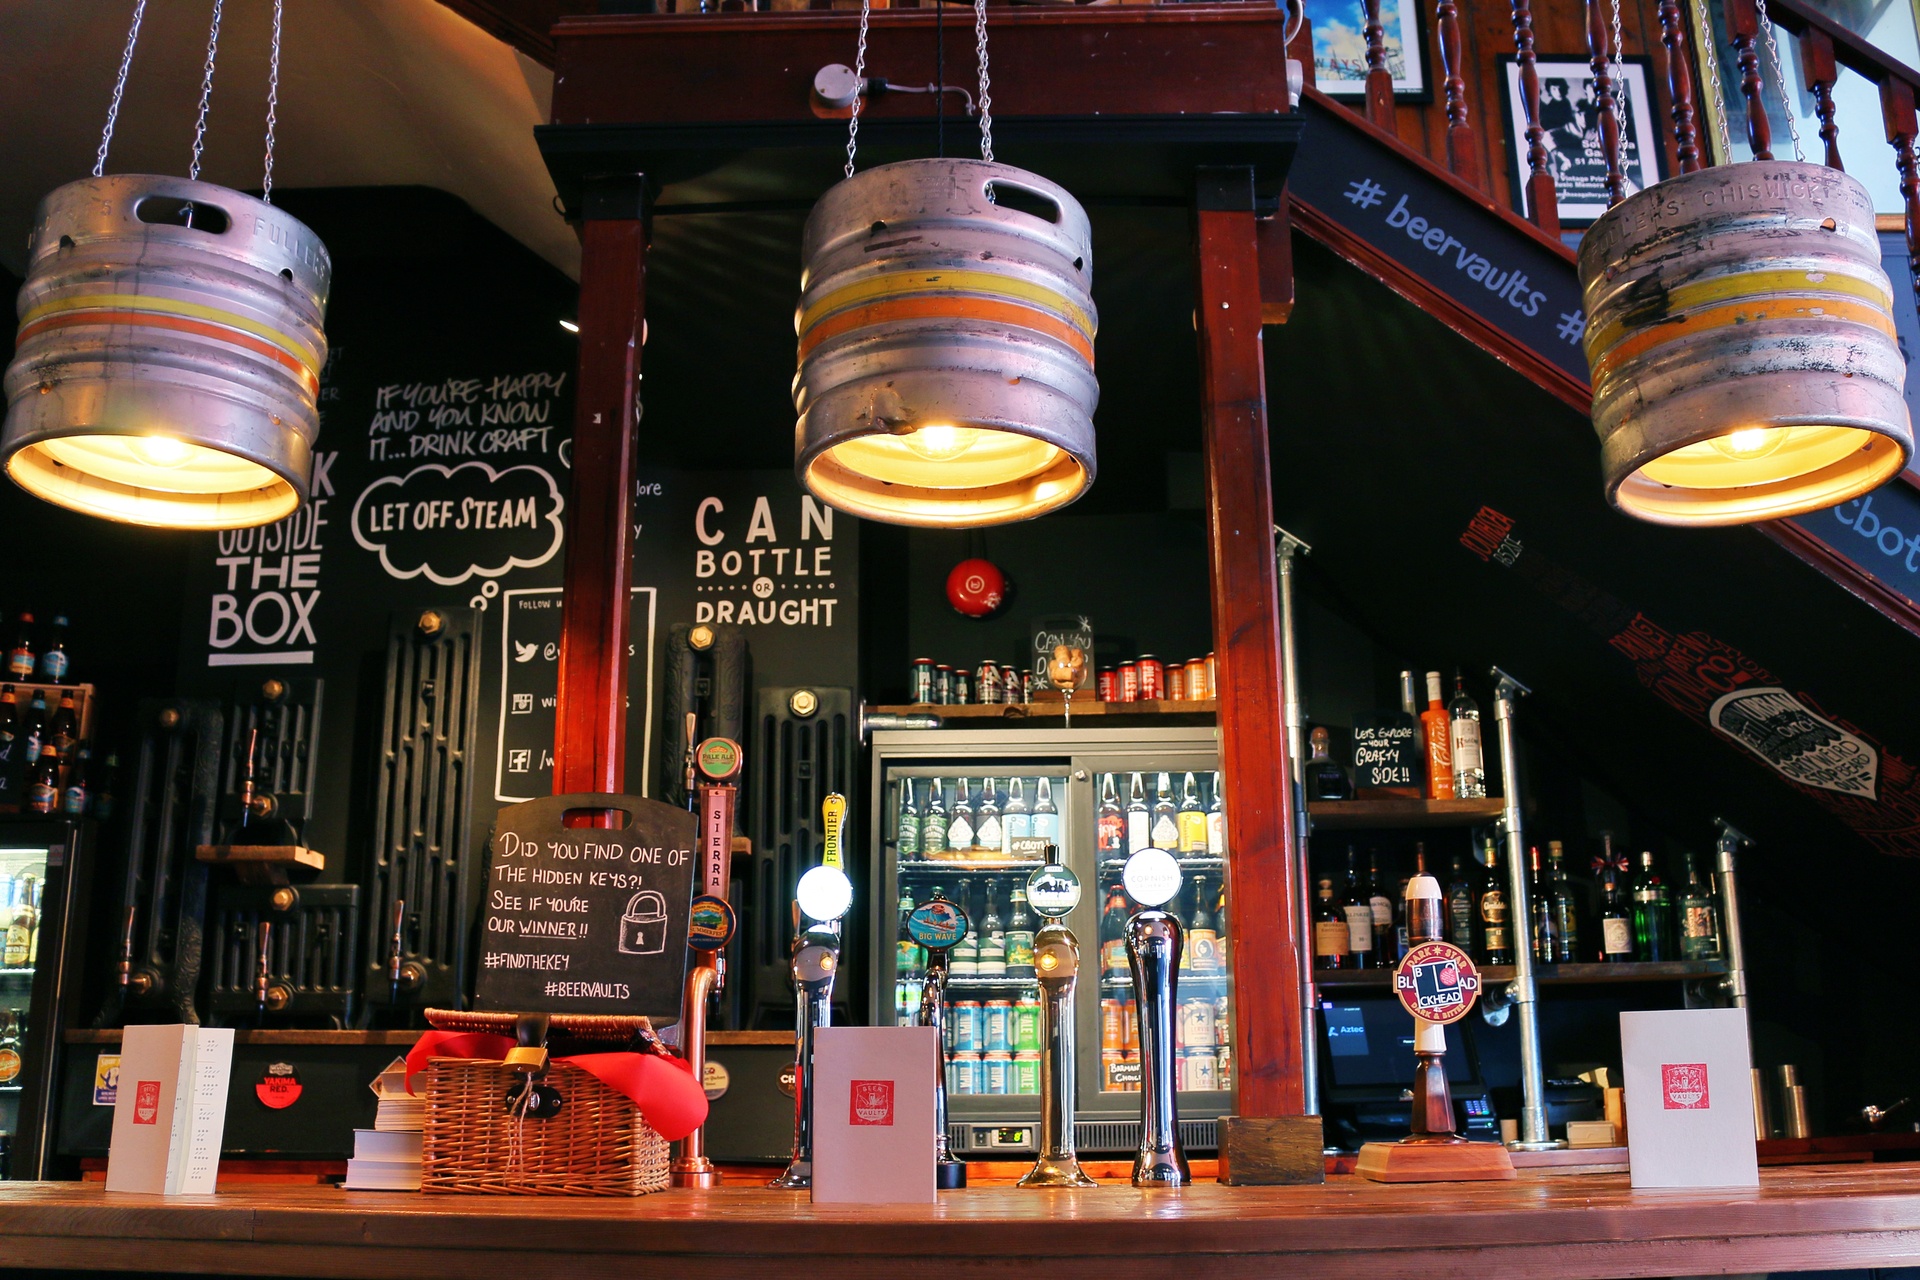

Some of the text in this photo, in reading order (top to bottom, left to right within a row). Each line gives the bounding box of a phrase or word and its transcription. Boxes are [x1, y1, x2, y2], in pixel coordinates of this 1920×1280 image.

[1703, 183, 1821, 206] CHISWICK
[1385, 194, 1547, 317] beervaults
[376, 385, 402, 410] IF
[485, 372, 566, 399] HAPPY
[369, 400, 550, 436] AND YOU KNOW
[409, 430, 477, 458] DRINK
[479, 426, 554, 453] CRAFT
[370, 496, 537, 532] LET OFF STEAM
[695, 495, 833, 545] CAN
[216, 554, 321, 590] THE
[695, 547, 832, 578] BOTTLE
[755, 583, 771, 592] OR
[519, 600, 551, 609] FOLLOW
[695, 599, 838, 627] DRAUGHT
[209, 590, 321, 648] BOX
[1355, 727, 1413, 739] LETS EXPLORE
[1835, 753, 1870, 776] BEARD
[827, 809, 837, 862] FRONTIER
[500, 832, 689, 866] DID YOU FIND ONE OF
[711, 809, 721, 887] SIERRA
[495, 864, 527, 882] THE
[532, 869, 582, 885] HIDDEN
[1131, 875, 1173, 883] CORNISH
[491, 890, 522, 911] SEE
[529, 896, 542, 910] IF
[487, 916, 514, 934] OUR
[919, 932, 957, 941] BIG WAVE
[484, 952, 570, 970] #FINDTHEKEY
[1407, 947, 1467, 969] DARK STAR
[544, 981, 630, 1000] #BEERVAULTS
[1411, 1003, 1430, 1018] DARK
[1443, 1004, 1465, 1019] BITTER
[264, 1077, 297, 1085] YAKIMA
